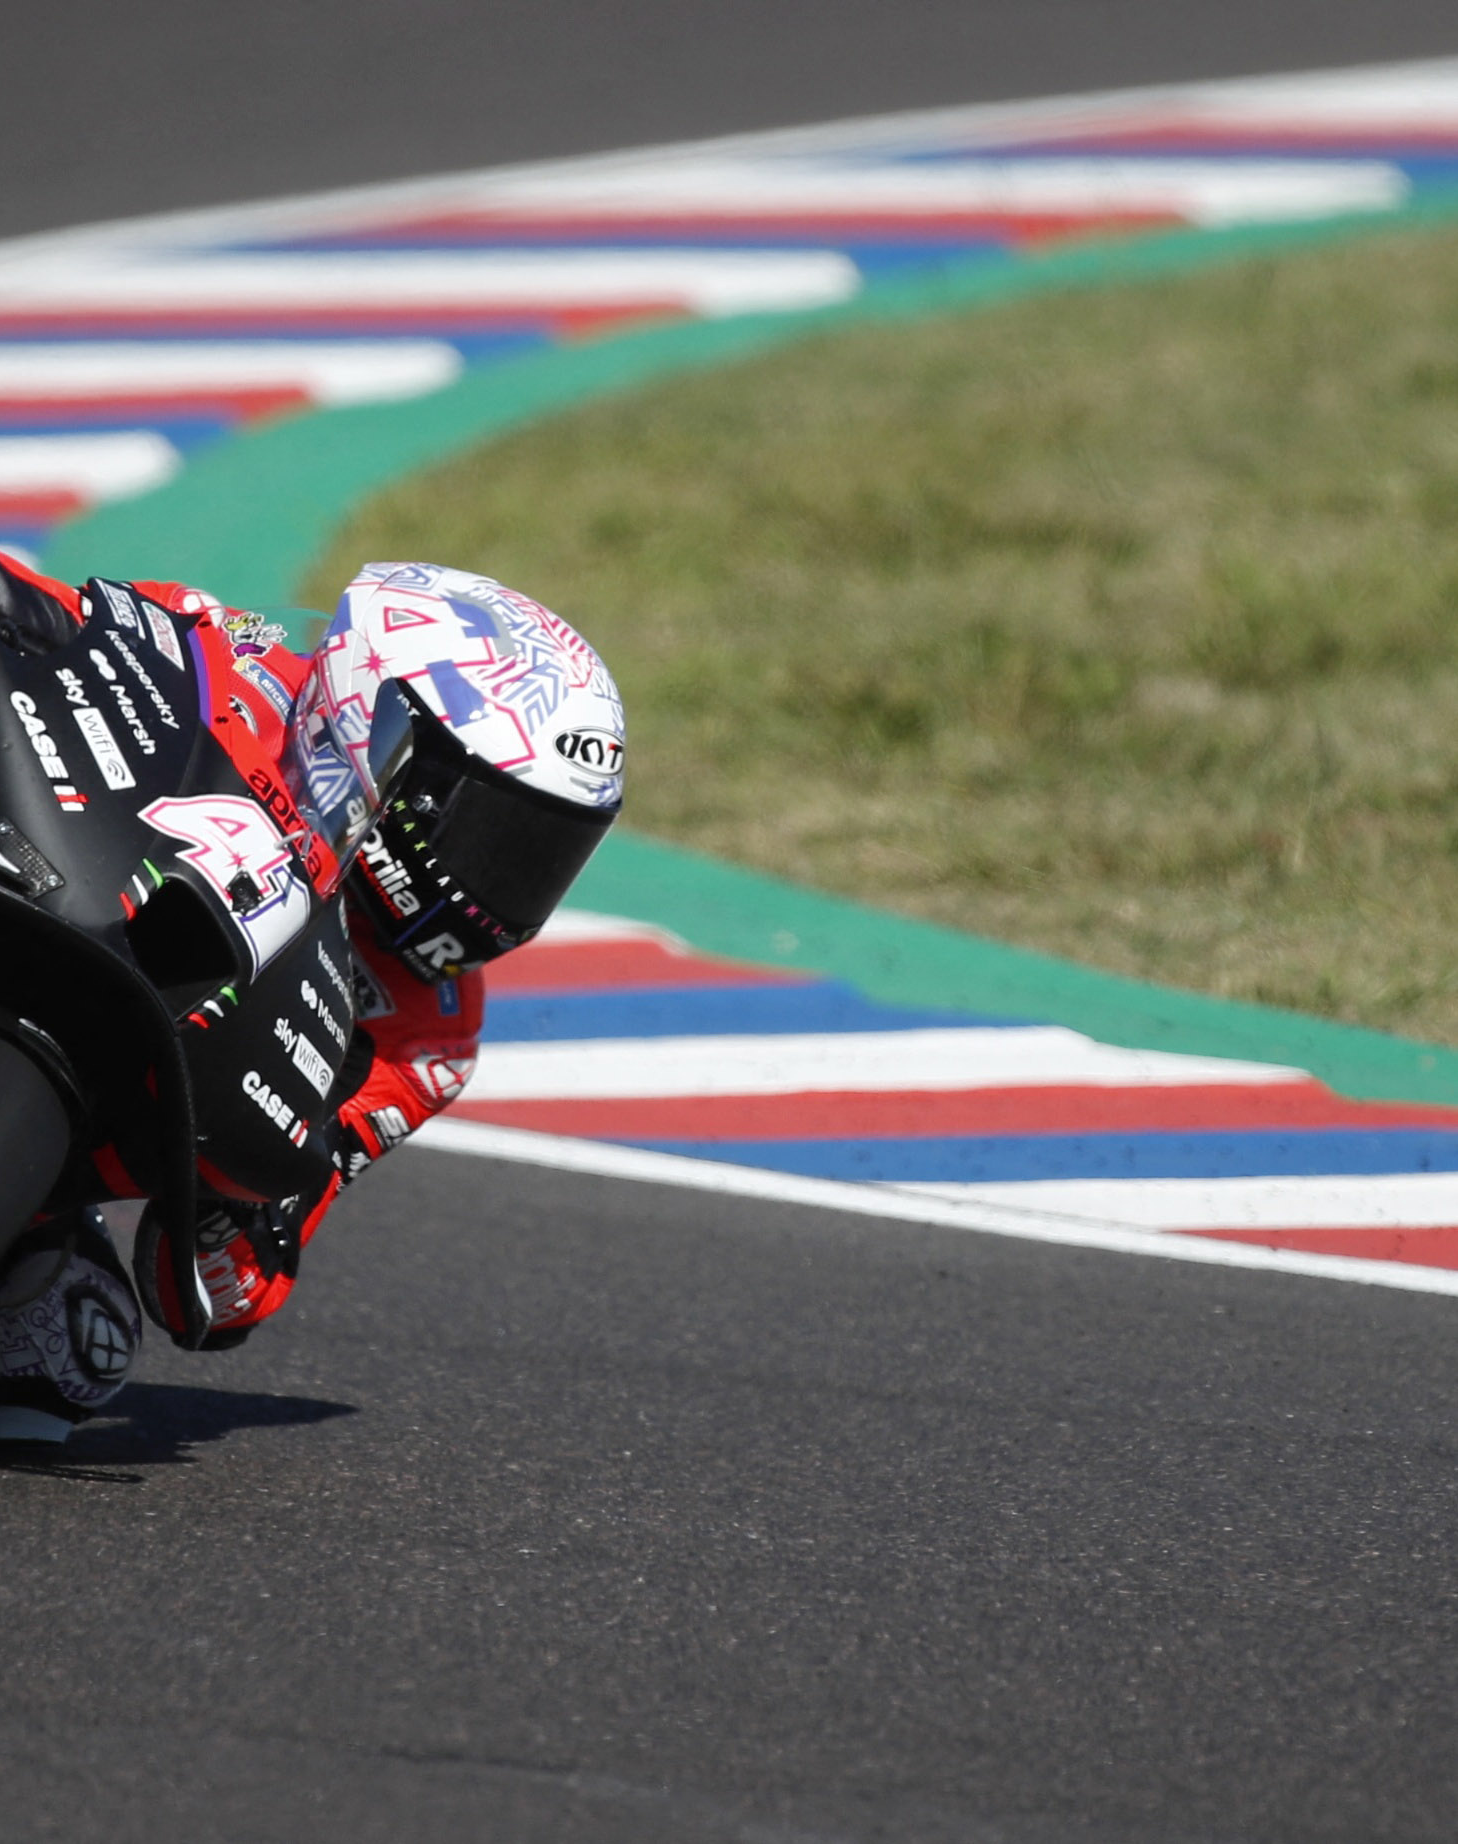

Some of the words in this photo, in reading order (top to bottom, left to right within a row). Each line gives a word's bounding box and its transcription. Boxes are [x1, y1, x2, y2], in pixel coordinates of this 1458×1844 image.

[55, 667, 91, 707] sky
[105, 629, 180, 729] kaspersky
[10, 690, 70, 779] CASE
[109, 685, 157, 755] Marsh
[555, 732, 624, 769] KYT
[273, 1017, 298, 1054] sky
[317, 998, 347, 1053] Marsh
[241, 1070, 295, 1132] CASE
